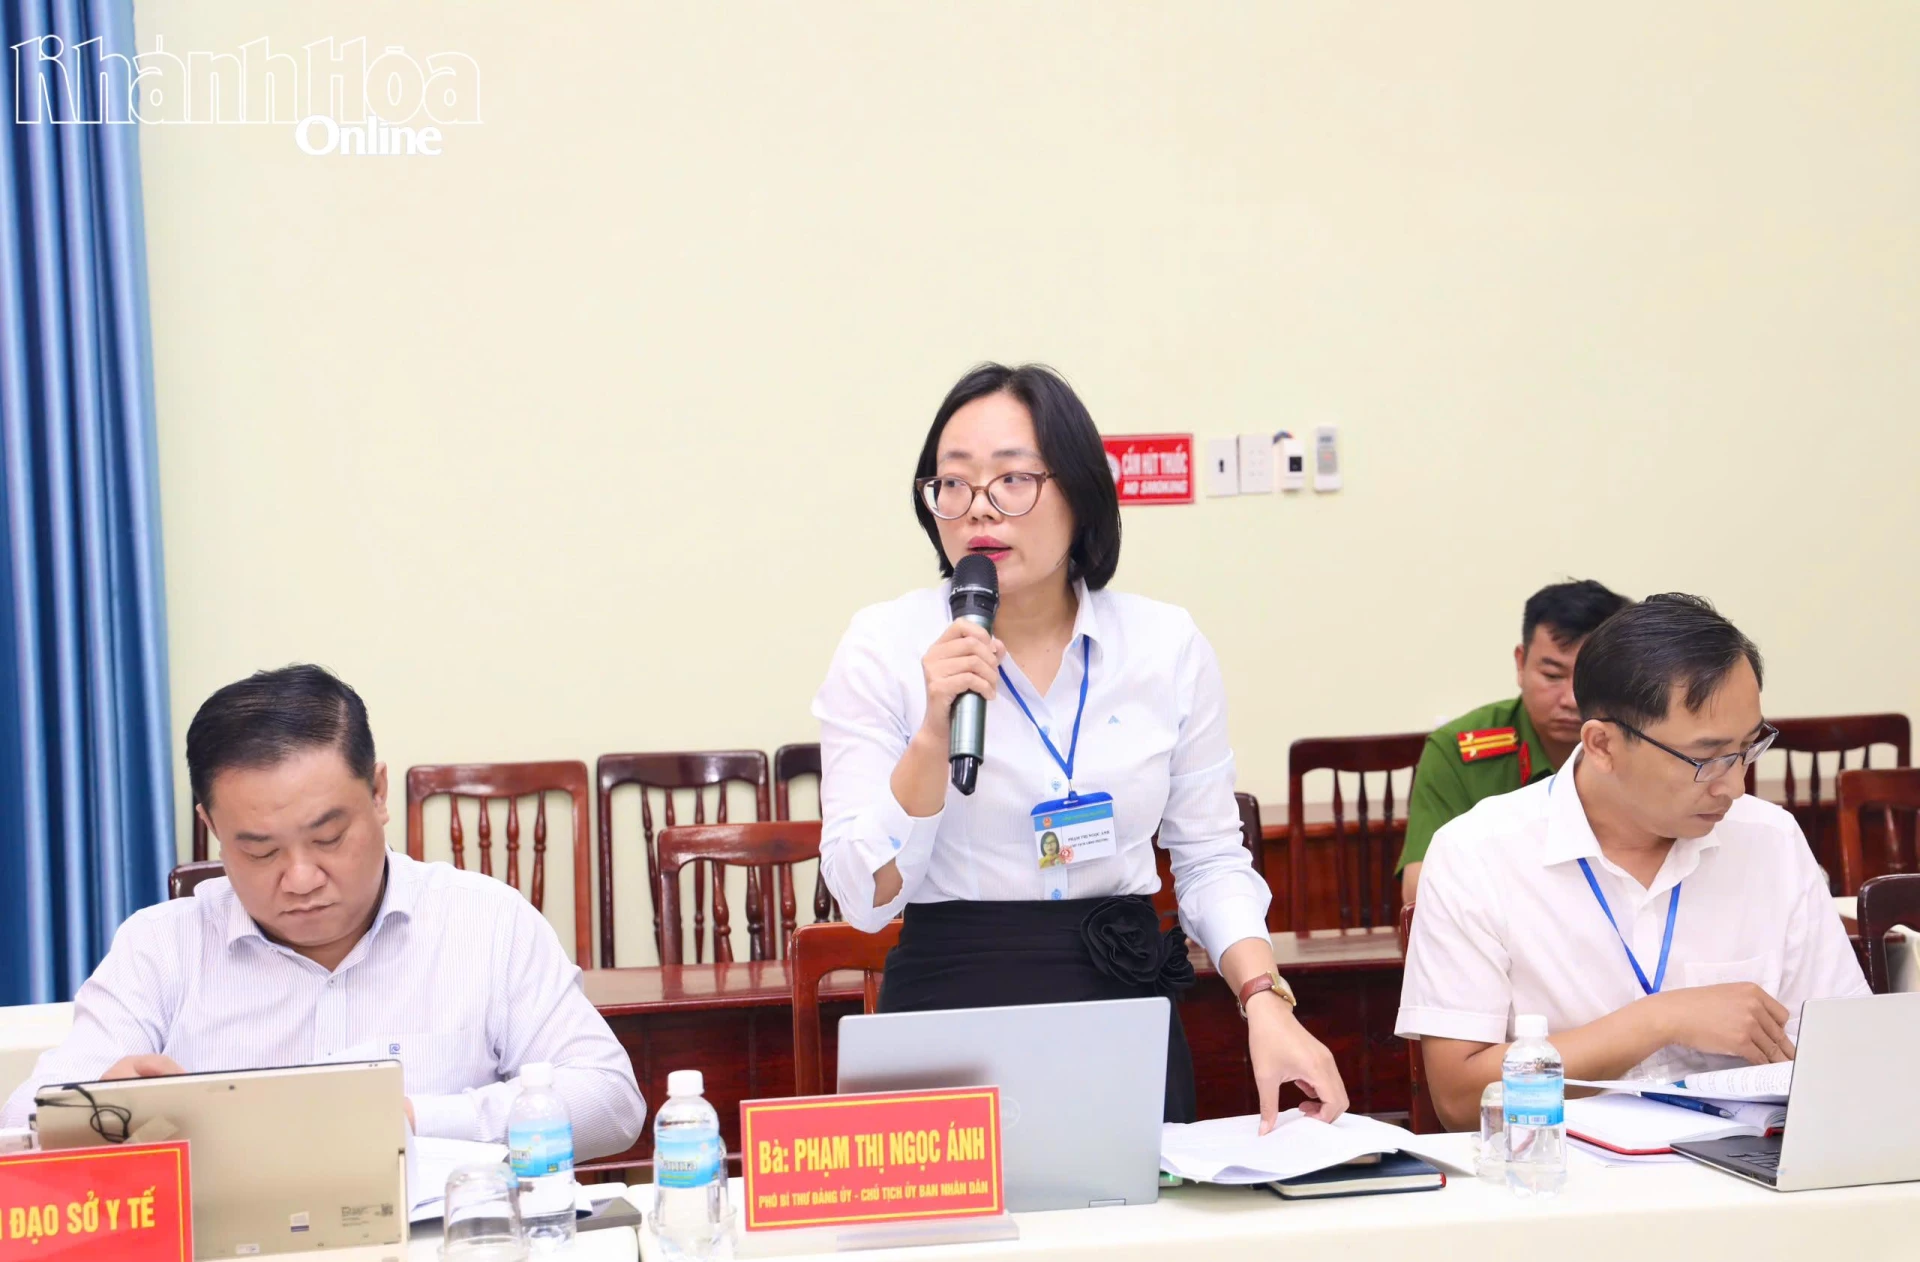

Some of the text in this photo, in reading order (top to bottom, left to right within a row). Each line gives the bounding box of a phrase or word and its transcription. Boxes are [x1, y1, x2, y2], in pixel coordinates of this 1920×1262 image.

[1122, 480, 1188, 495] NO SMOKING
[758, 1121, 985, 1178] Bà: PHẠM THỊ NGỌC ÁNH
[792, 1190, 811, 1206] THƯ
[882, 1186, 903, 1202] TỊCH
[919, 1184, 938, 1198] BAN
[941, 1180, 967, 1196] NHÂN
[9, 1204, 59, 1245] ĐẠO
[67, 1190, 99, 1234] SỞ
[105, 1199, 121, 1230] Y
[127, 1185, 156, 1229] TẾ
